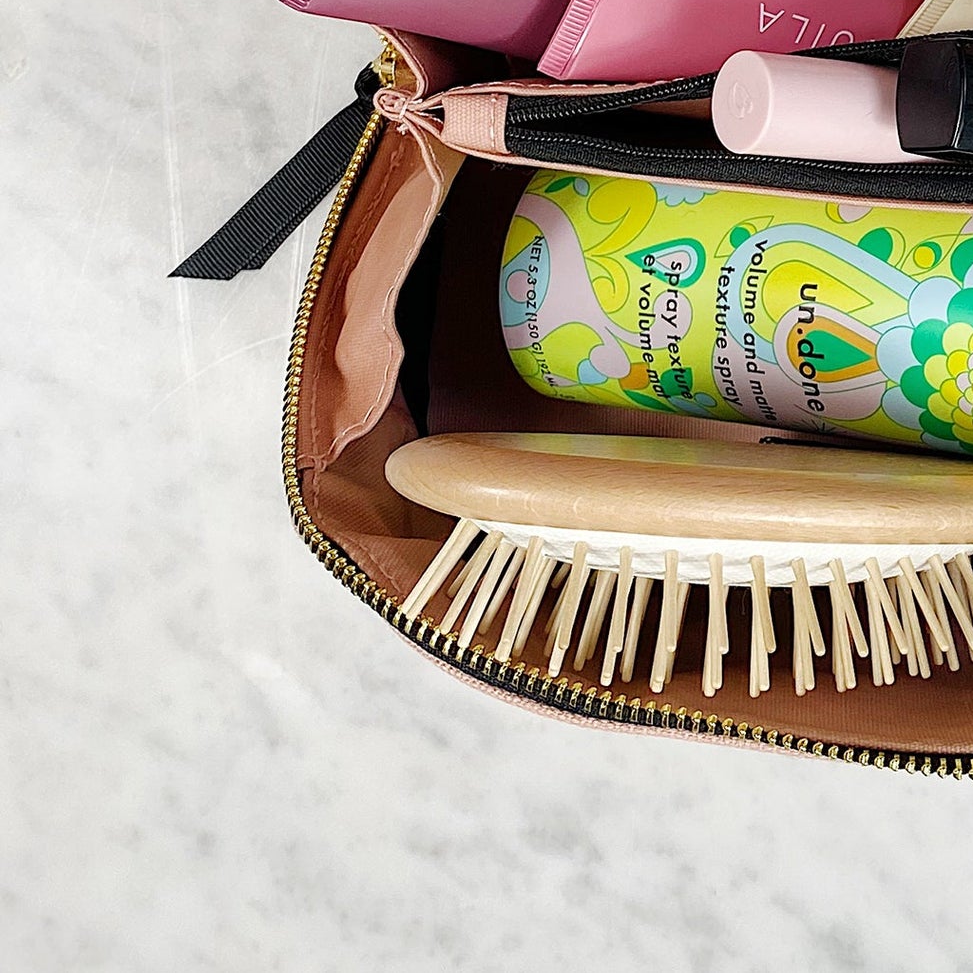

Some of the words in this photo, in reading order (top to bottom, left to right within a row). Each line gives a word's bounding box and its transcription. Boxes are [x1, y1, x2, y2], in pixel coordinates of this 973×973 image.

[529, 235, 545, 263] NET
[642, 253, 658, 276] et
[527, 265, 539, 286] 5.3
[660, 260, 683, 329] spray
[742, 239, 770, 325] volume
[526, 289, 537, 309] OZ
[715, 265, 735, 350] texture
[525, 312, 539, 339] (150
[638, 282, 657, 364] volume
[666, 334, 694, 400] texture
[743, 332, 766, 375] and
[796, 283, 826, 413] un.done
[646, 368, 670, 400] mat
[713, 355, 744, 408] spray
[749, 379, 779, 422] matte
